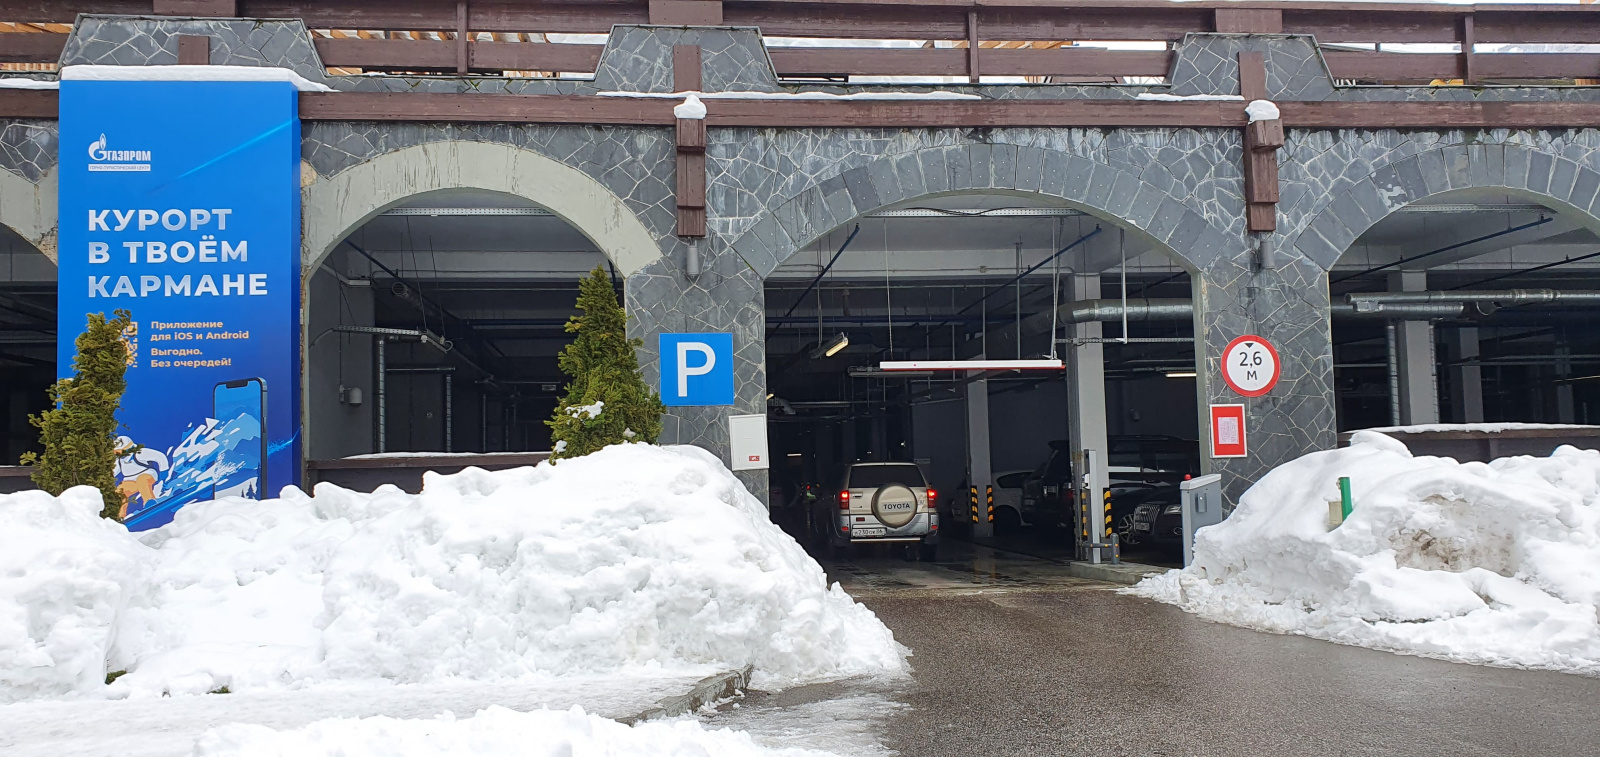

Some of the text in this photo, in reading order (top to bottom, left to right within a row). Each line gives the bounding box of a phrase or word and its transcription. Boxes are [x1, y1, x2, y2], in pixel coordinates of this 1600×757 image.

[88, 208, 232, 231] КУРОРТ
[88, 234, 248, 264] В ТВОЁМ
[88, 273, 268, 297] КАРМАНЕ
[150, 321, 224, 330] Приложение
[150, 334, 171, 342] для
[174, 332, 193, 340] iOS
[206, 331, 250, 340] Android
[150, 348, 203, 356] Выгодно.
[150, 358, 232, 368] Без очередей!
[1239, 351, 1263, 368] 2,6
[676, 342, 716, 397] P
[1246, 370, 1258, 381] М
